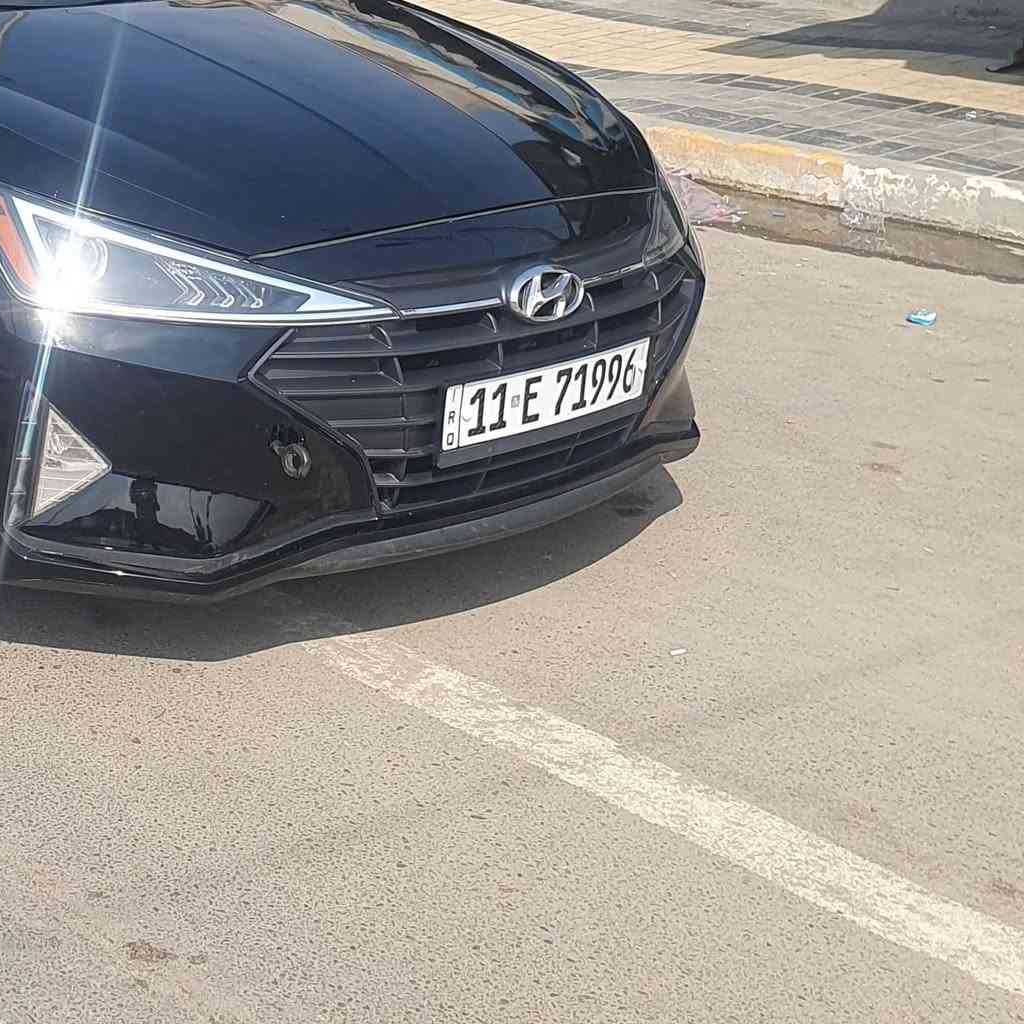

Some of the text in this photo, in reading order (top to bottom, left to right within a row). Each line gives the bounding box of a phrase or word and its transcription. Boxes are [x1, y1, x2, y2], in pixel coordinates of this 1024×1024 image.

[467, 348, 637, 437] 11 E 71996
